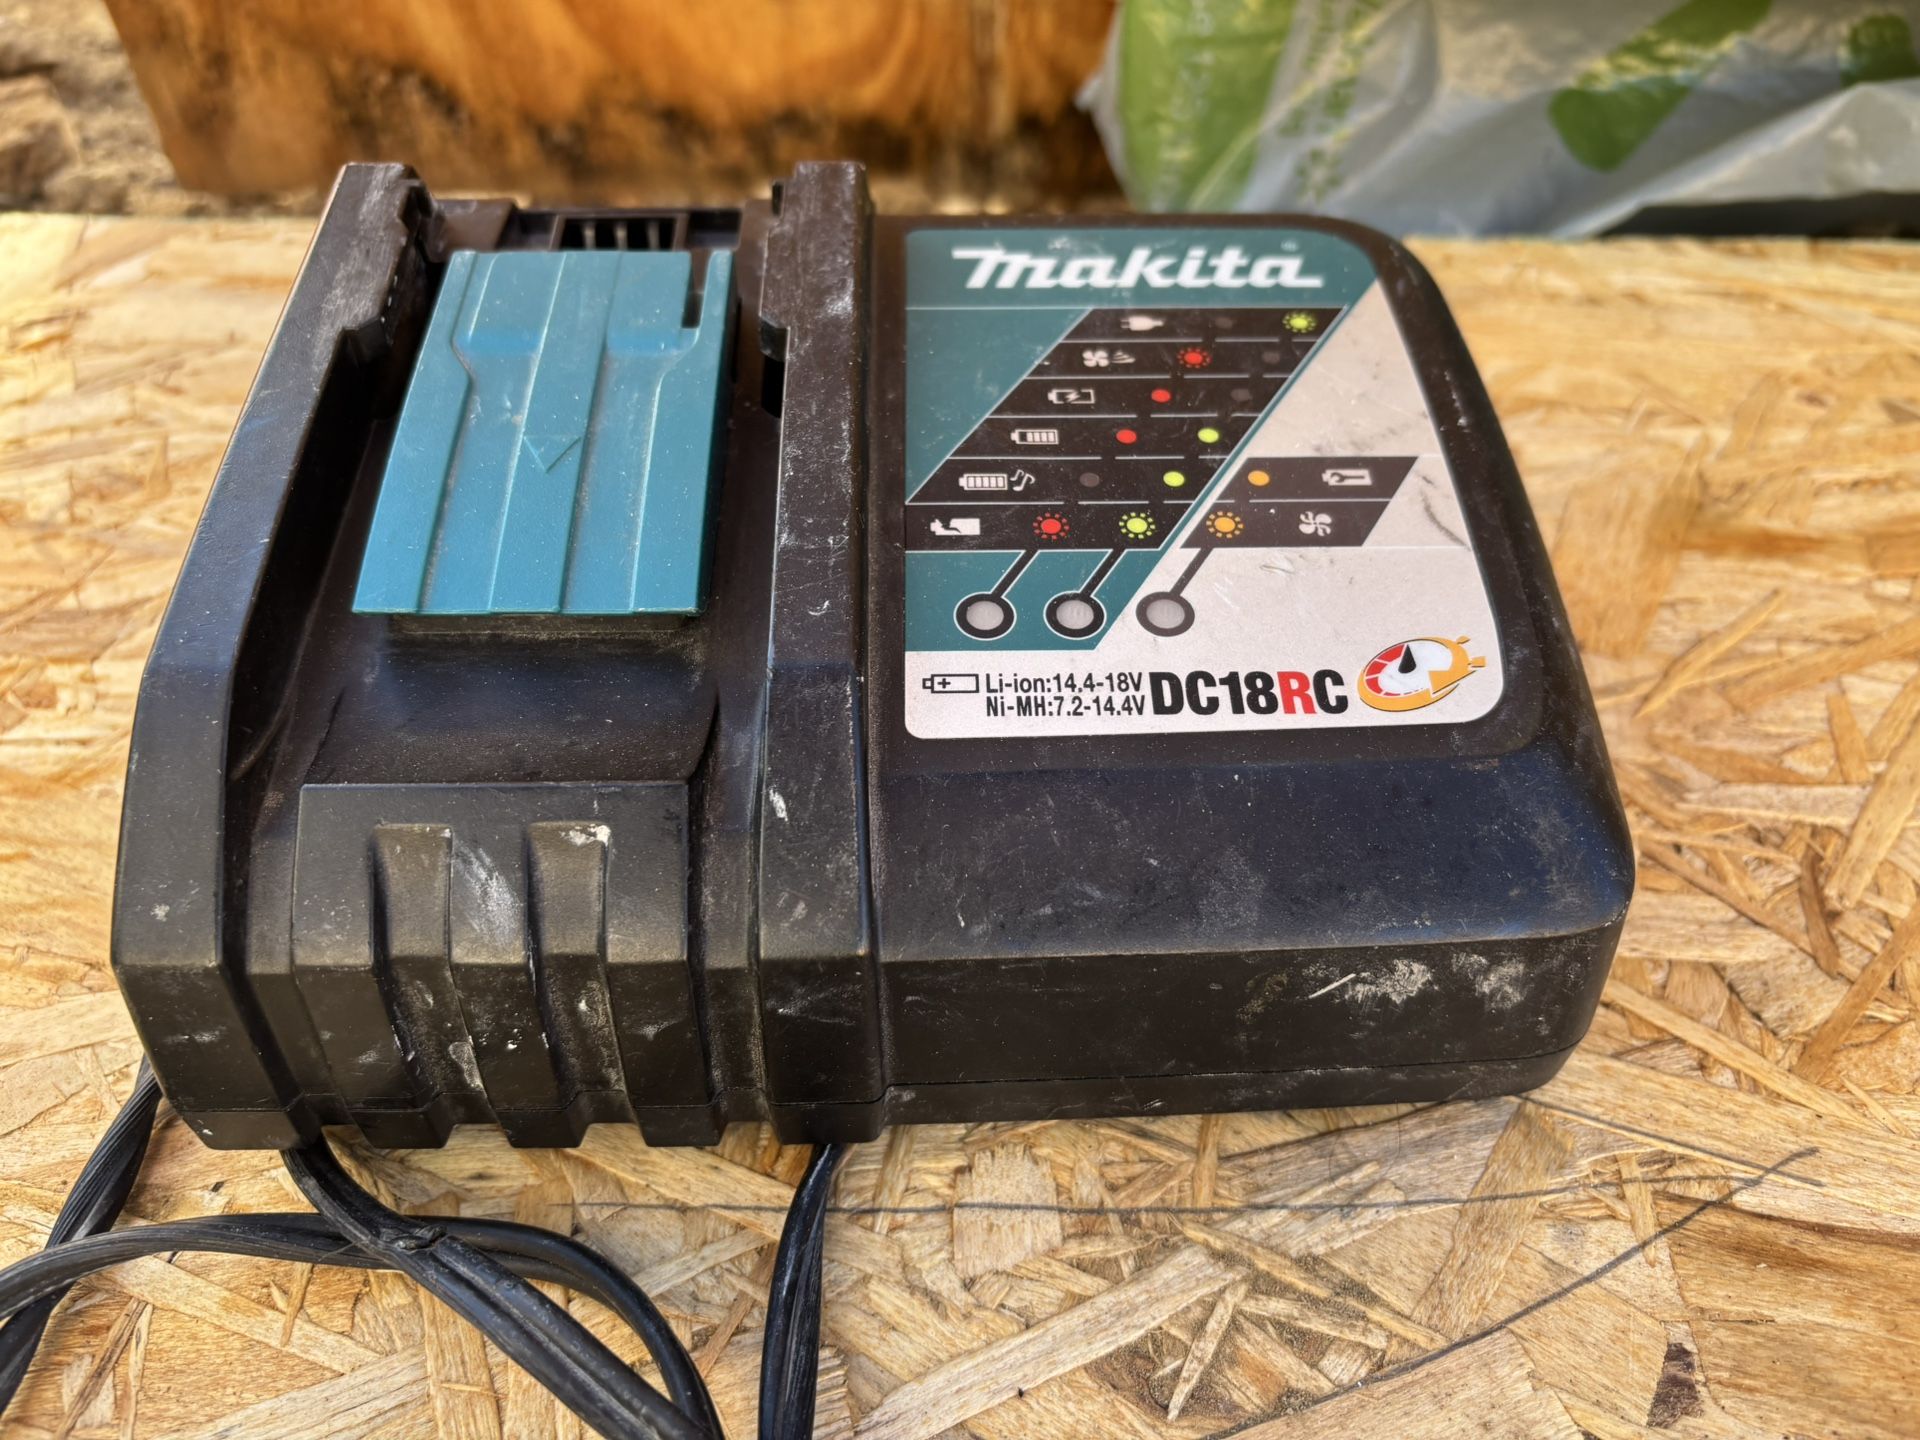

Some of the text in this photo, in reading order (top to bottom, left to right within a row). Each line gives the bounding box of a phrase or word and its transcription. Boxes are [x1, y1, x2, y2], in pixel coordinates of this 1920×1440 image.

[952, 246, 1324, 289] makita
[985, 672, 1143, 695] Li-ion:14.4-18V
[1149, 670, 1349, 716] DC18RC
[985, 694, 1147, 717] Ni-MH:7.2-14.4V
